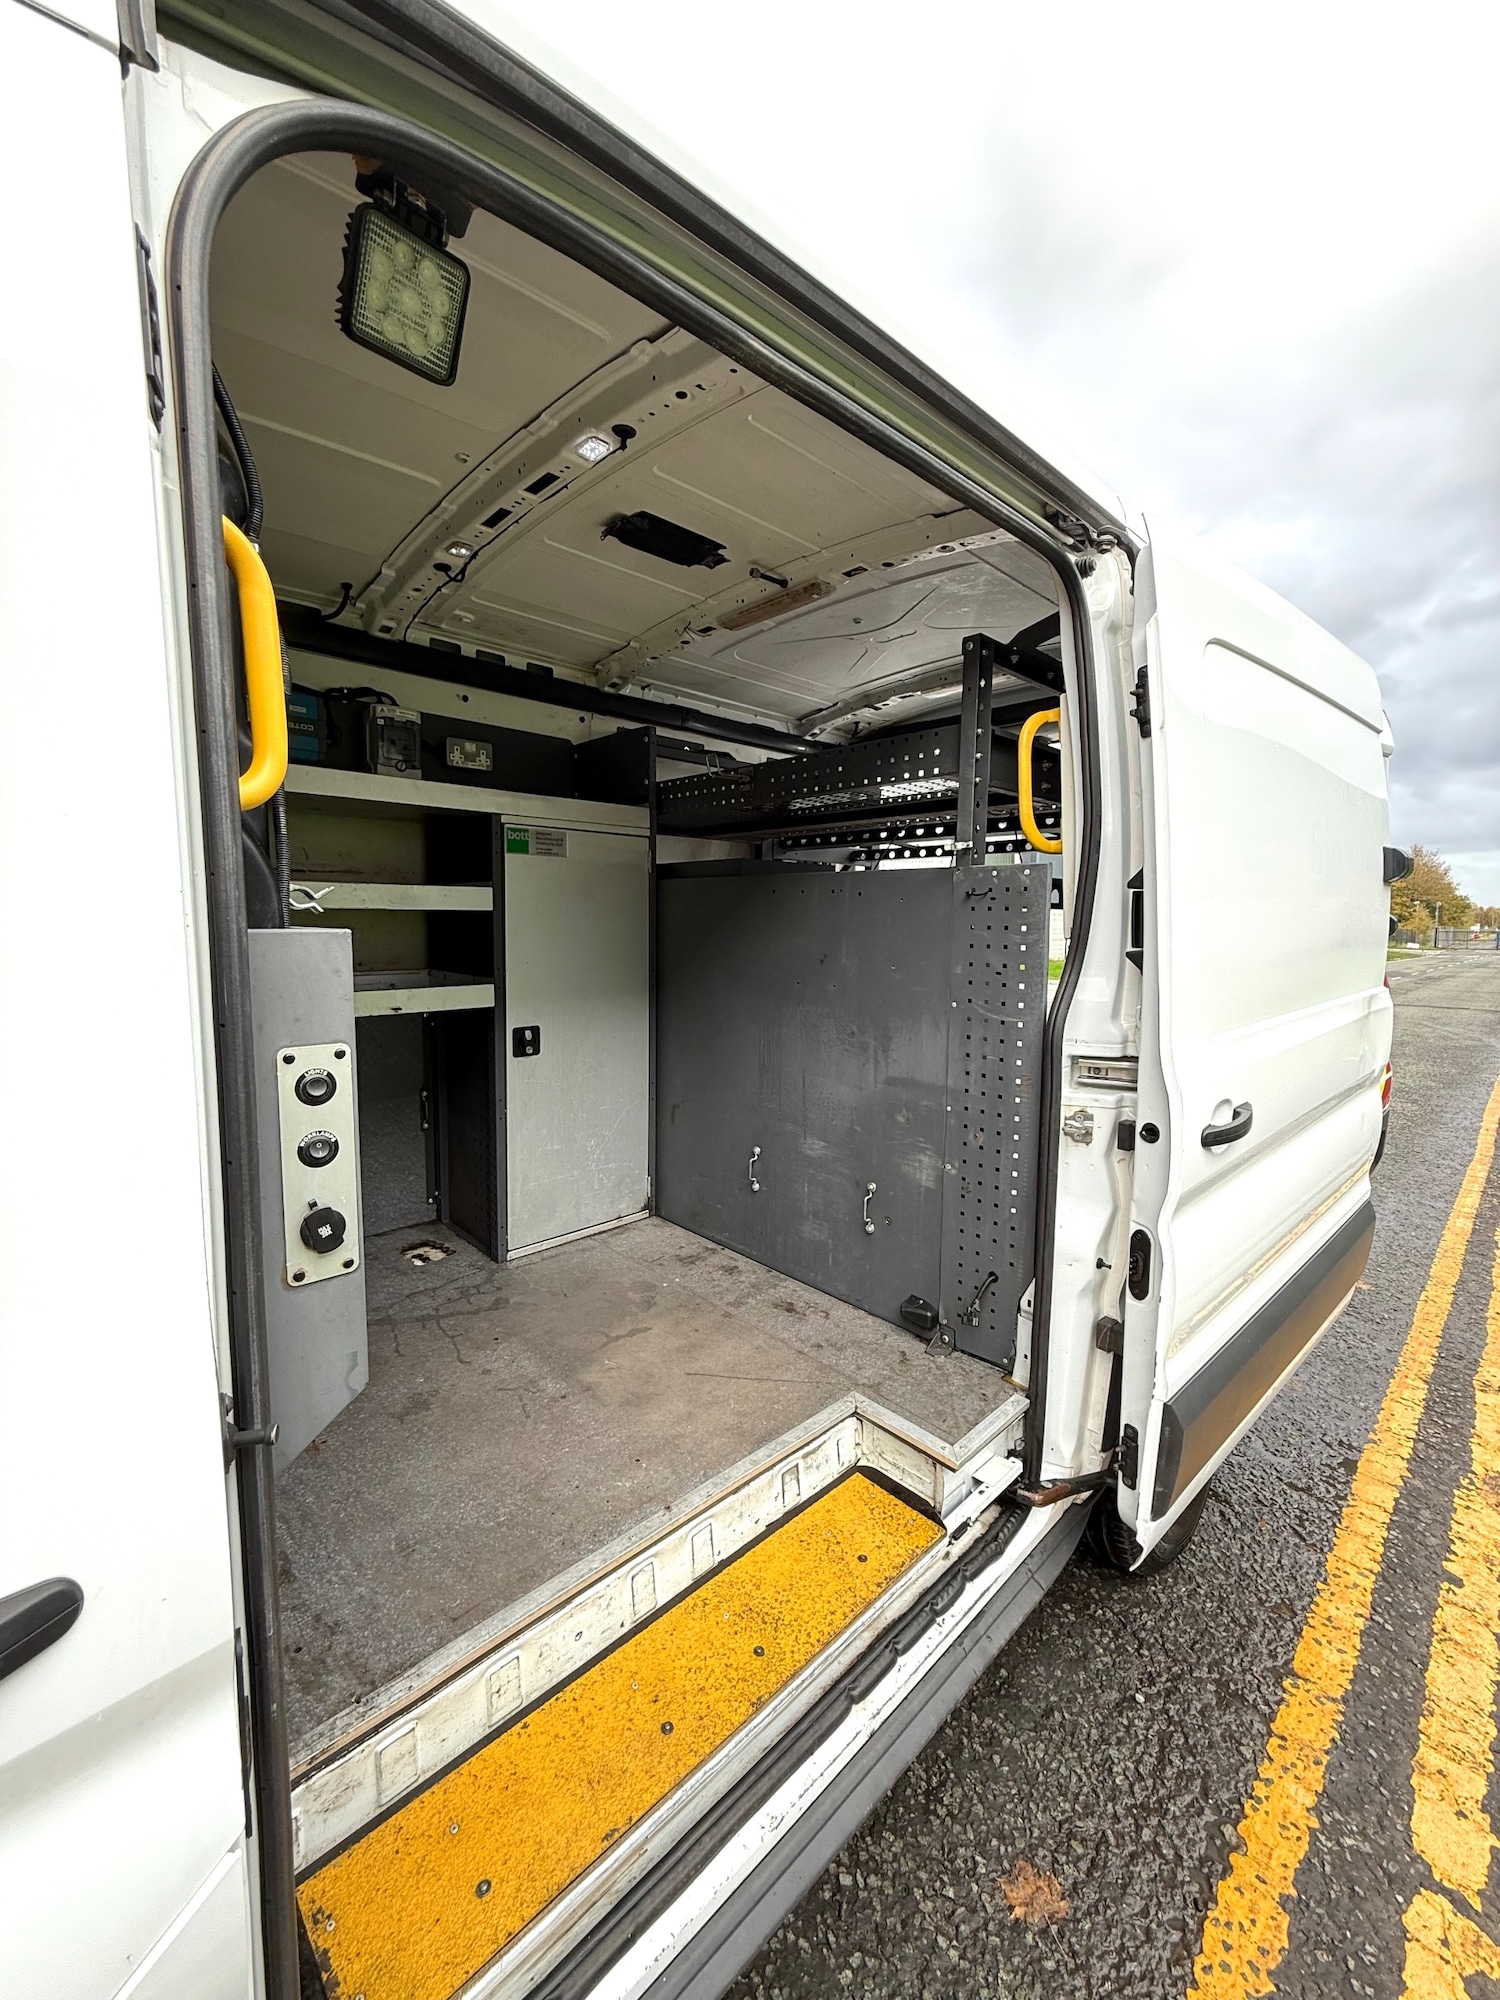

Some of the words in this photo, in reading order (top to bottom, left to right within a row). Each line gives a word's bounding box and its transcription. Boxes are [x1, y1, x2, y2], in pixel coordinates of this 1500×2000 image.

[508, 829, 530, 840] bott
[304, 1068, 329, 1078] LIGHTS
[299, 1131, 337, 1147] WORKLAMPS
